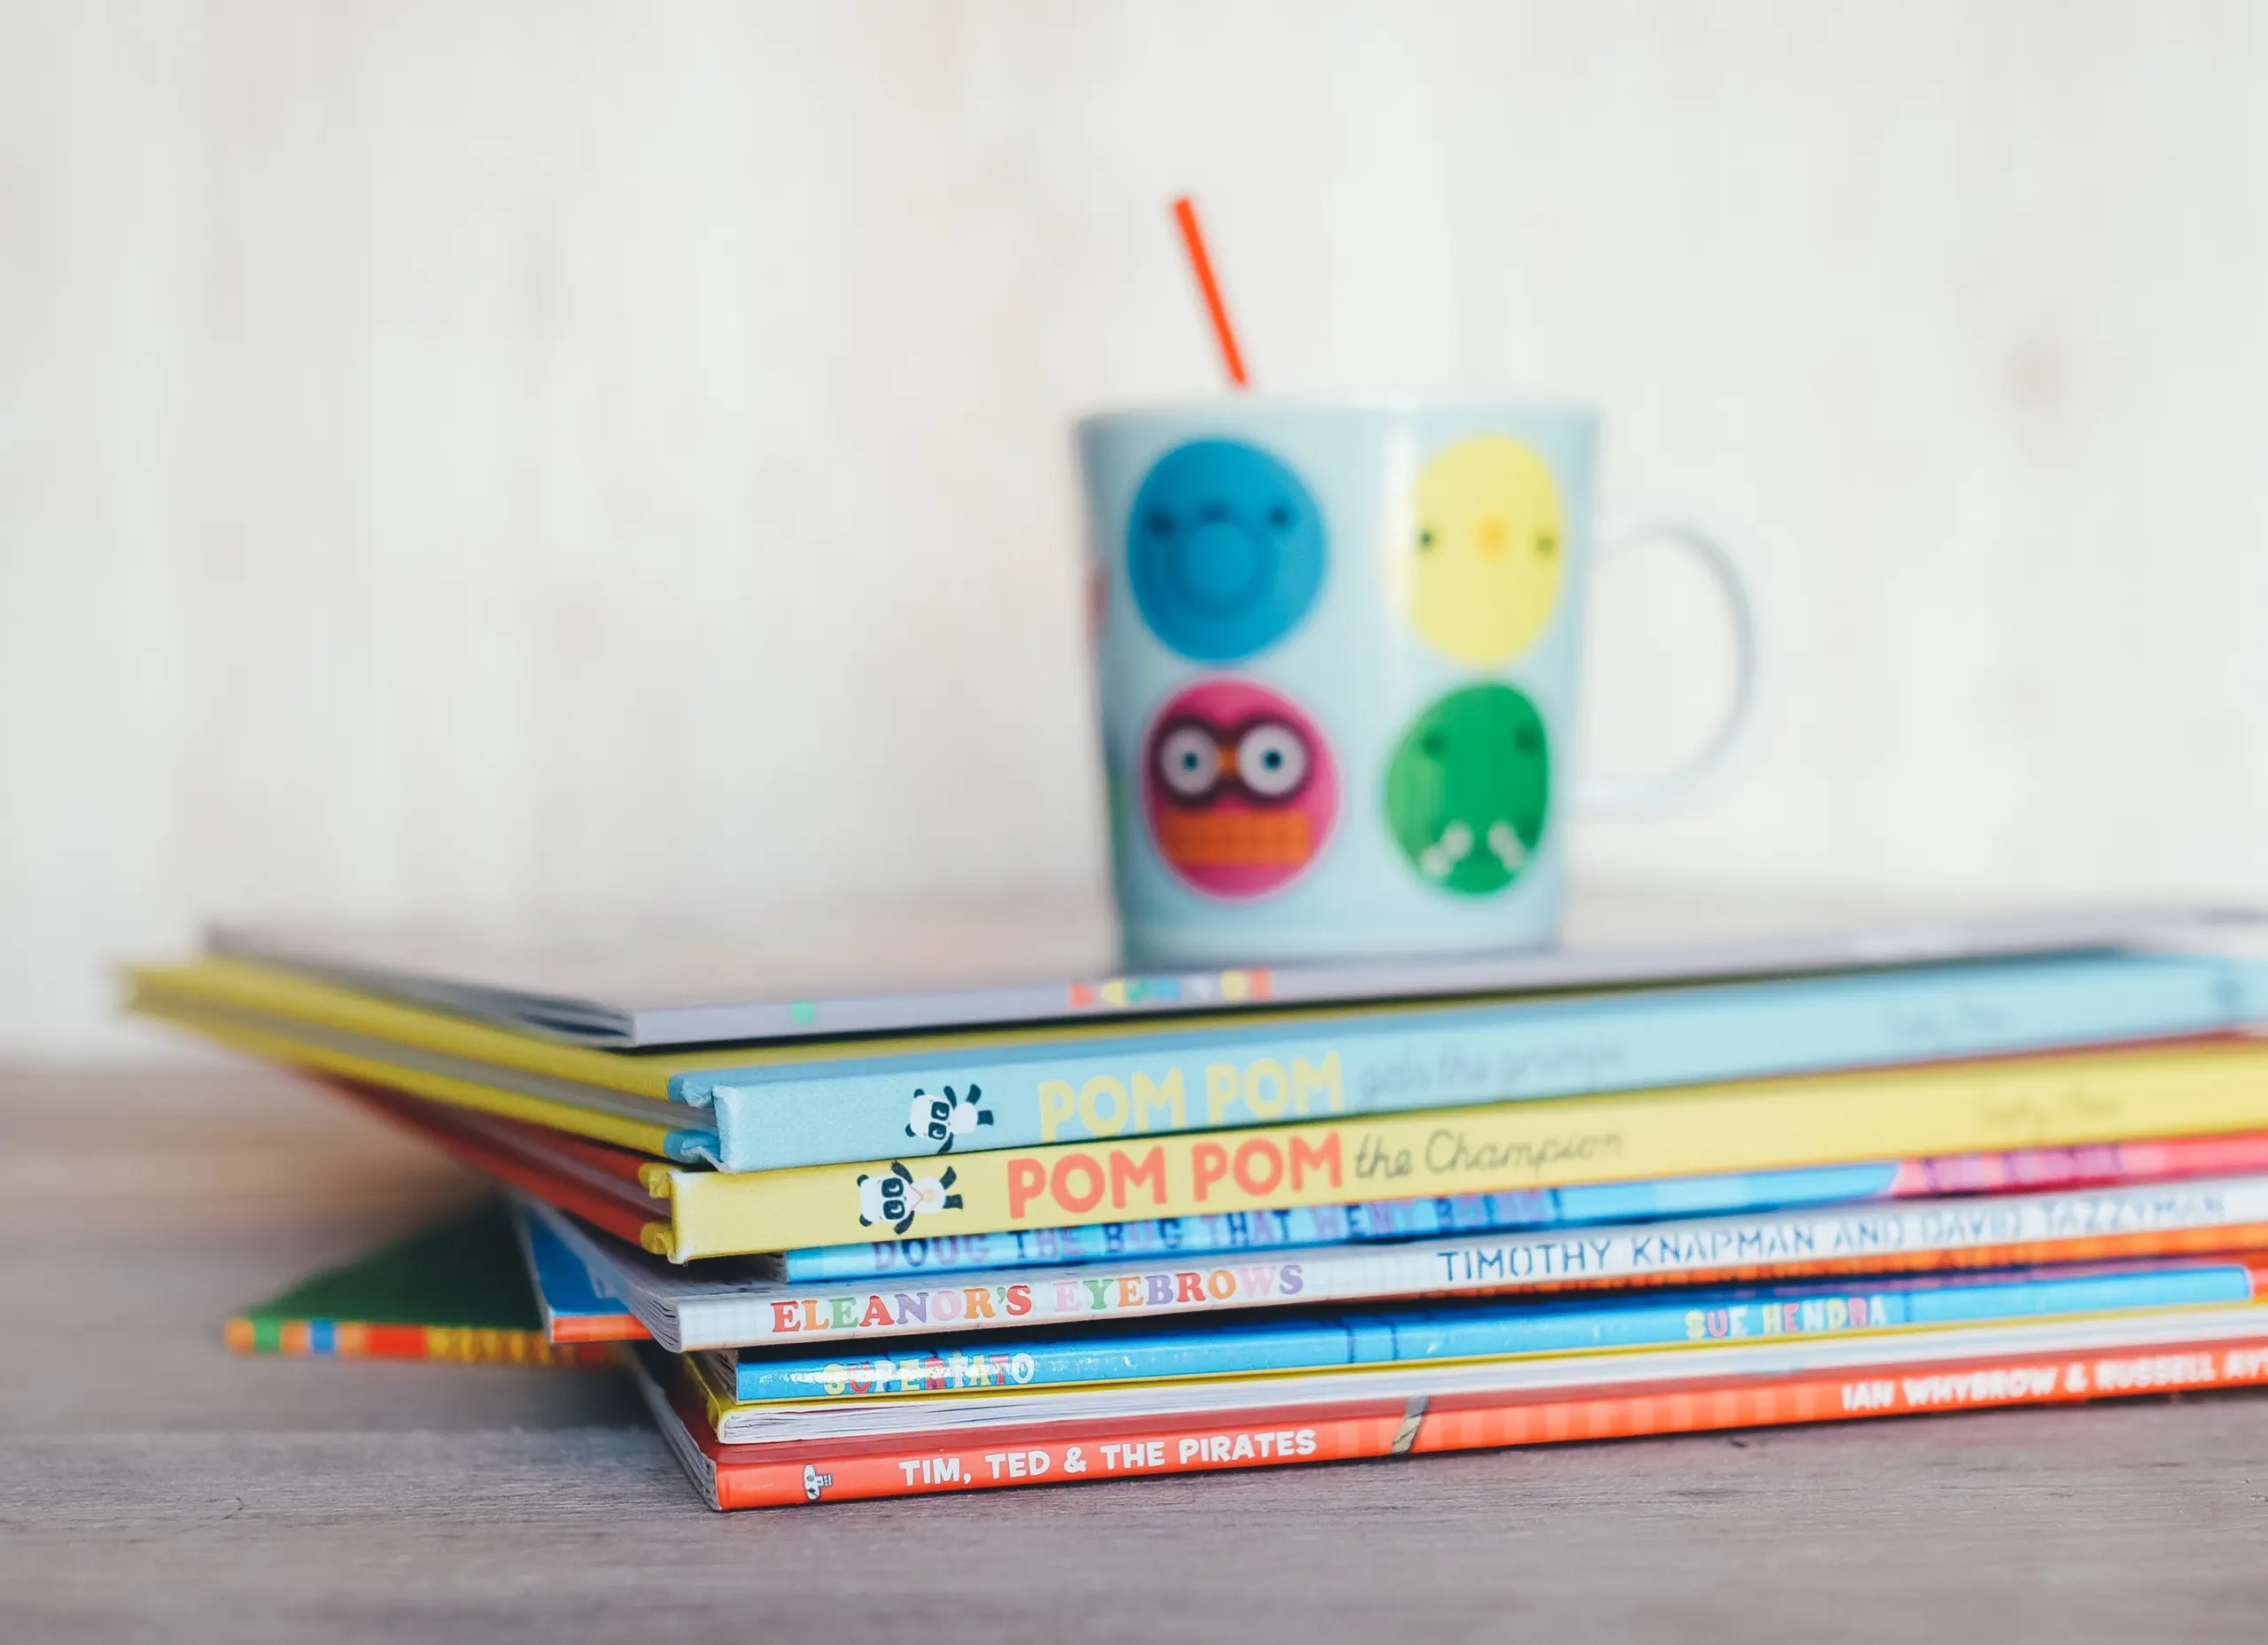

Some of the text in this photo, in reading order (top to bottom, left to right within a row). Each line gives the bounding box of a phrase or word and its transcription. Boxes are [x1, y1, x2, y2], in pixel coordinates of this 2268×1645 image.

[1039, 1067, 1187, 1143] POM
[1206, 1051, 1343, 1113] POM
[1007, 1129, 1621, 1219] POM POM the Champion
[1437, 1240, 1612, 1283] TIMOTHY
[1632, 1222, 1816, 1269] KNAPMAN
[771, 1264, 1304, 1332] ELEANOR'S EYEBROWS
[1683, 1294, 1888, 1340] SUE HENDRA
[823, 1352, 1035, 1395] SUPERTATO
[1841, 1380, 1896, 1411] IAN
[1902, 1367, 2058, 1407] WHYBROW
[2063, 1362, 2088, 1393] &
[898, 1428, 1317, 1486] TIM, TED & THE PIRATES
